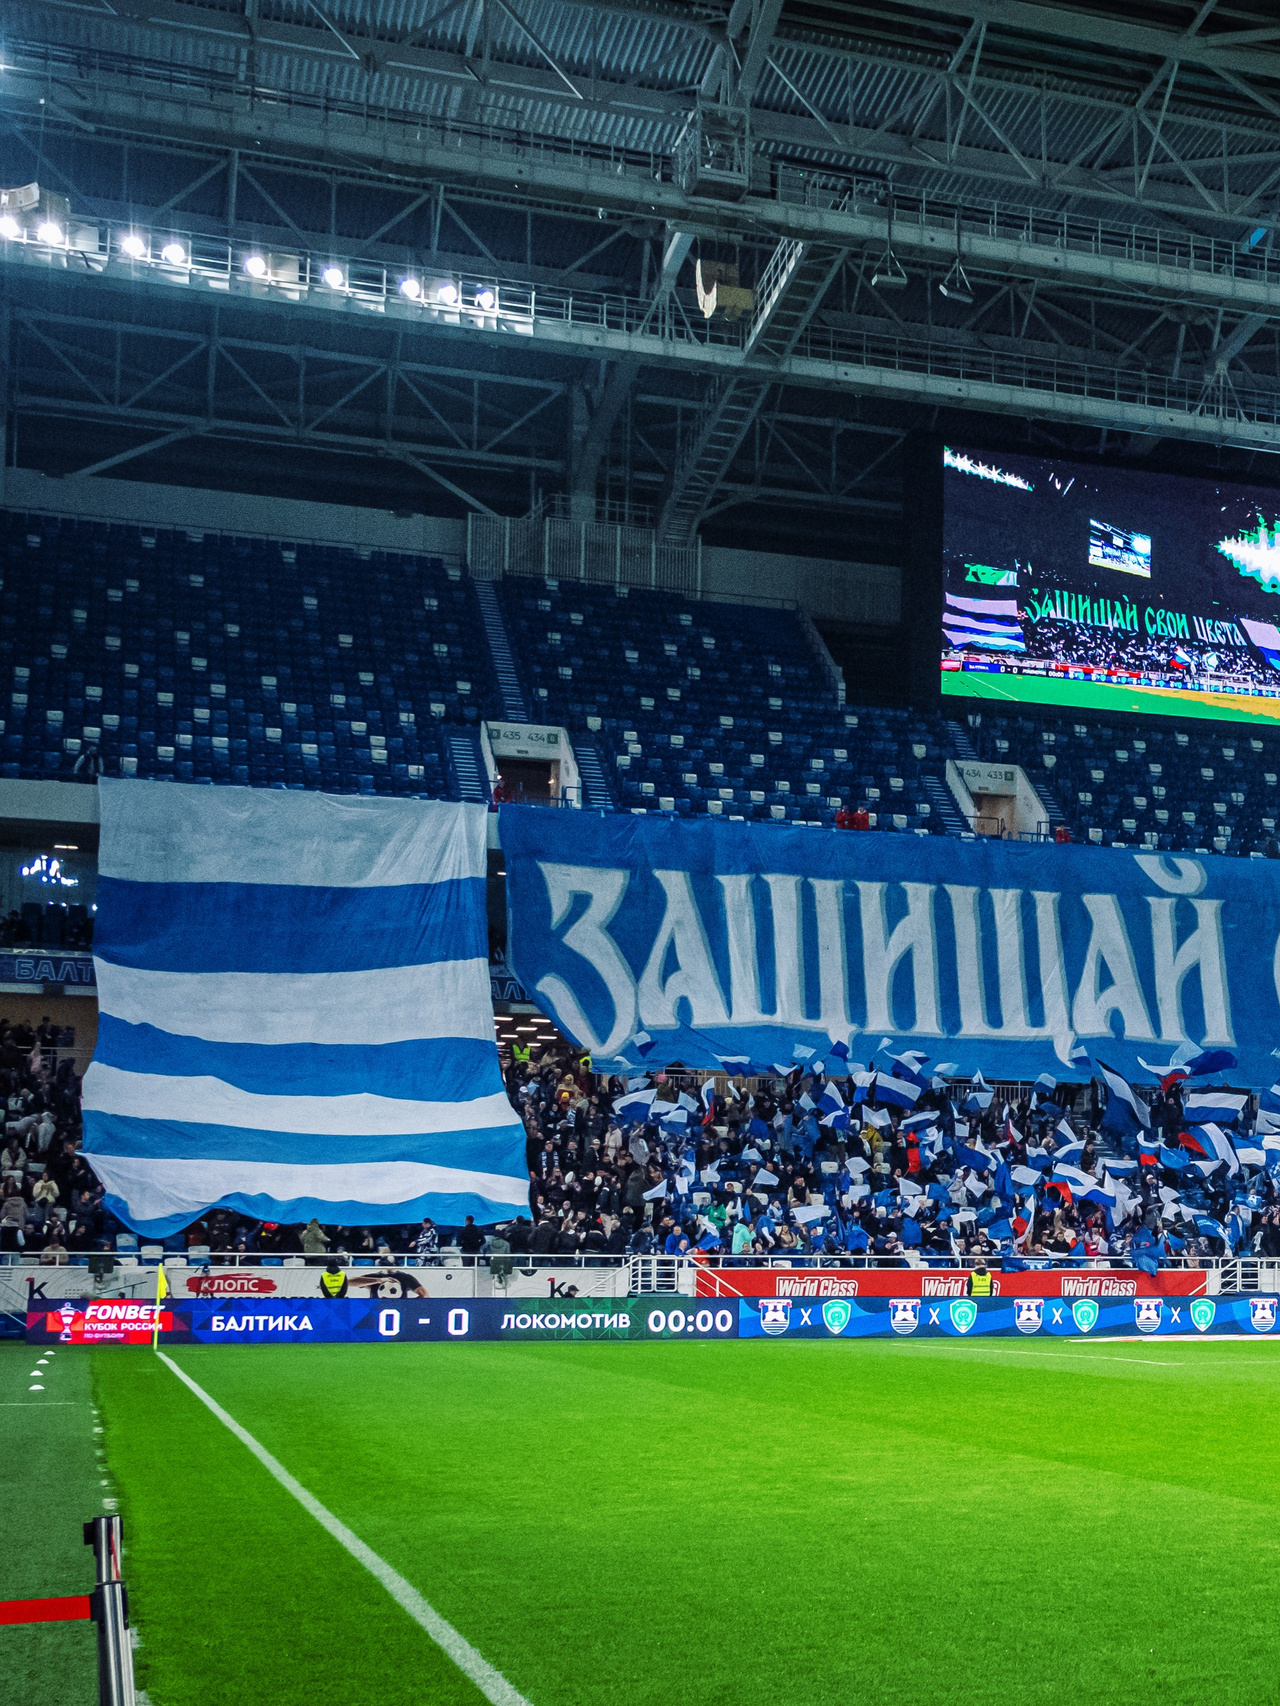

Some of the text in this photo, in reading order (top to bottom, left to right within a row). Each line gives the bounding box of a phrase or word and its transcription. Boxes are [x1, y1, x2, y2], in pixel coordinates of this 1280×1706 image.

[503, 730, 521, 741] 435
[528, 733, 545, 743] 434
[534, 853, 1237, 1067] ЗАЩИЩАЙ
[15, 958, 95, 983] БАЛТ
[200, 1279, 260, 1292] КЛОПС
[779, 1279, 856, 1297] World Class
[924, 1279, 963, 1297] World
[1064, 1279, 1134, 1297] World Class
[85, 1305, 165, 1320] FONBET
[500, 1313, 631, 1330] ЛОКОМОТИВ
[648, 1308, 734, 1334] 00:00
[84, 1322, 118, 1331] КУБОК
[211, 1315, 314, 1332] БАЛТИКА
[378, 1308, 401, 1336] 0
[447, 1308, 470, 1336] 0
